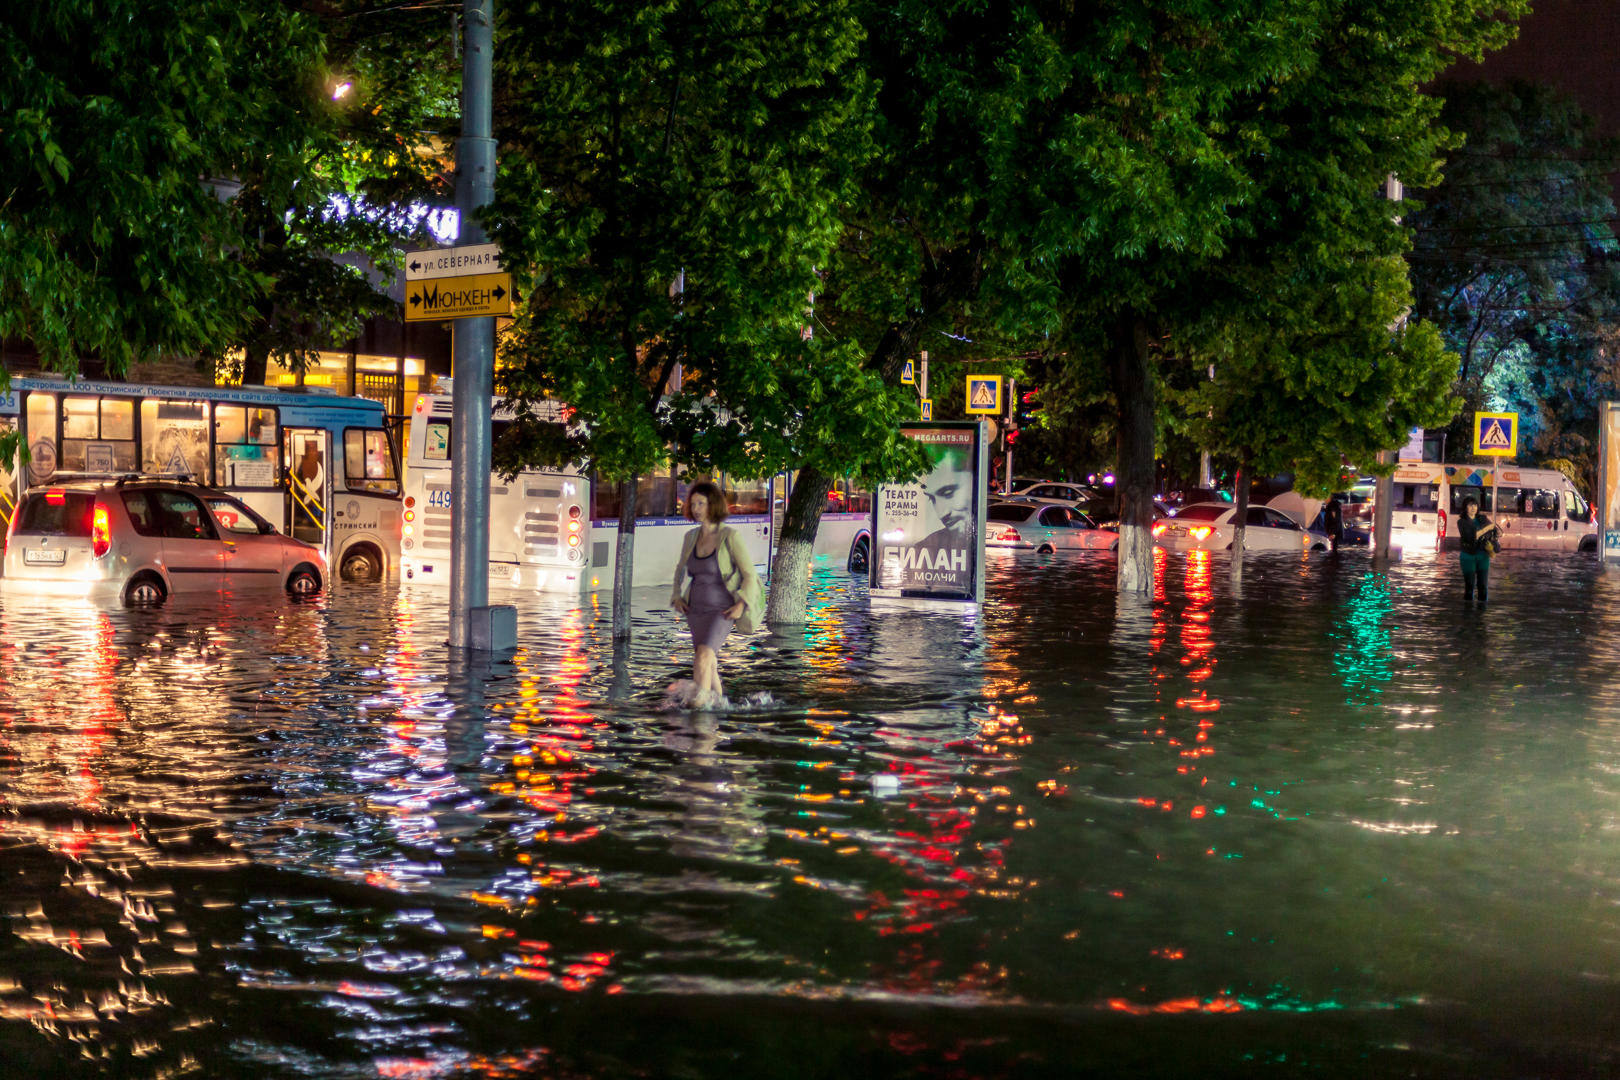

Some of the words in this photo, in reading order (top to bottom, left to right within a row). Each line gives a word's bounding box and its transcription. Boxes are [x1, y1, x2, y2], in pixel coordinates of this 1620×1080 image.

[424, 261, 435, 273] ул.
[437, 253, 490, 270] СЕВЕРНАЯ
[424, 283, 490, 309] МЮНХЕН
[914, 434, 970, 442] MEGAARTS.RU
[429, 489, 451, 508] 449
[885, 489, 918, 500] ТЕАТР
[885, 501, 918, 510] ДРАМЫ
[334, 521, 377, 530] СТРИНСКИЙ
[883, 546, 967, 571] БИЛАН
[914, 571, 956, 583] МОЛЧИ
